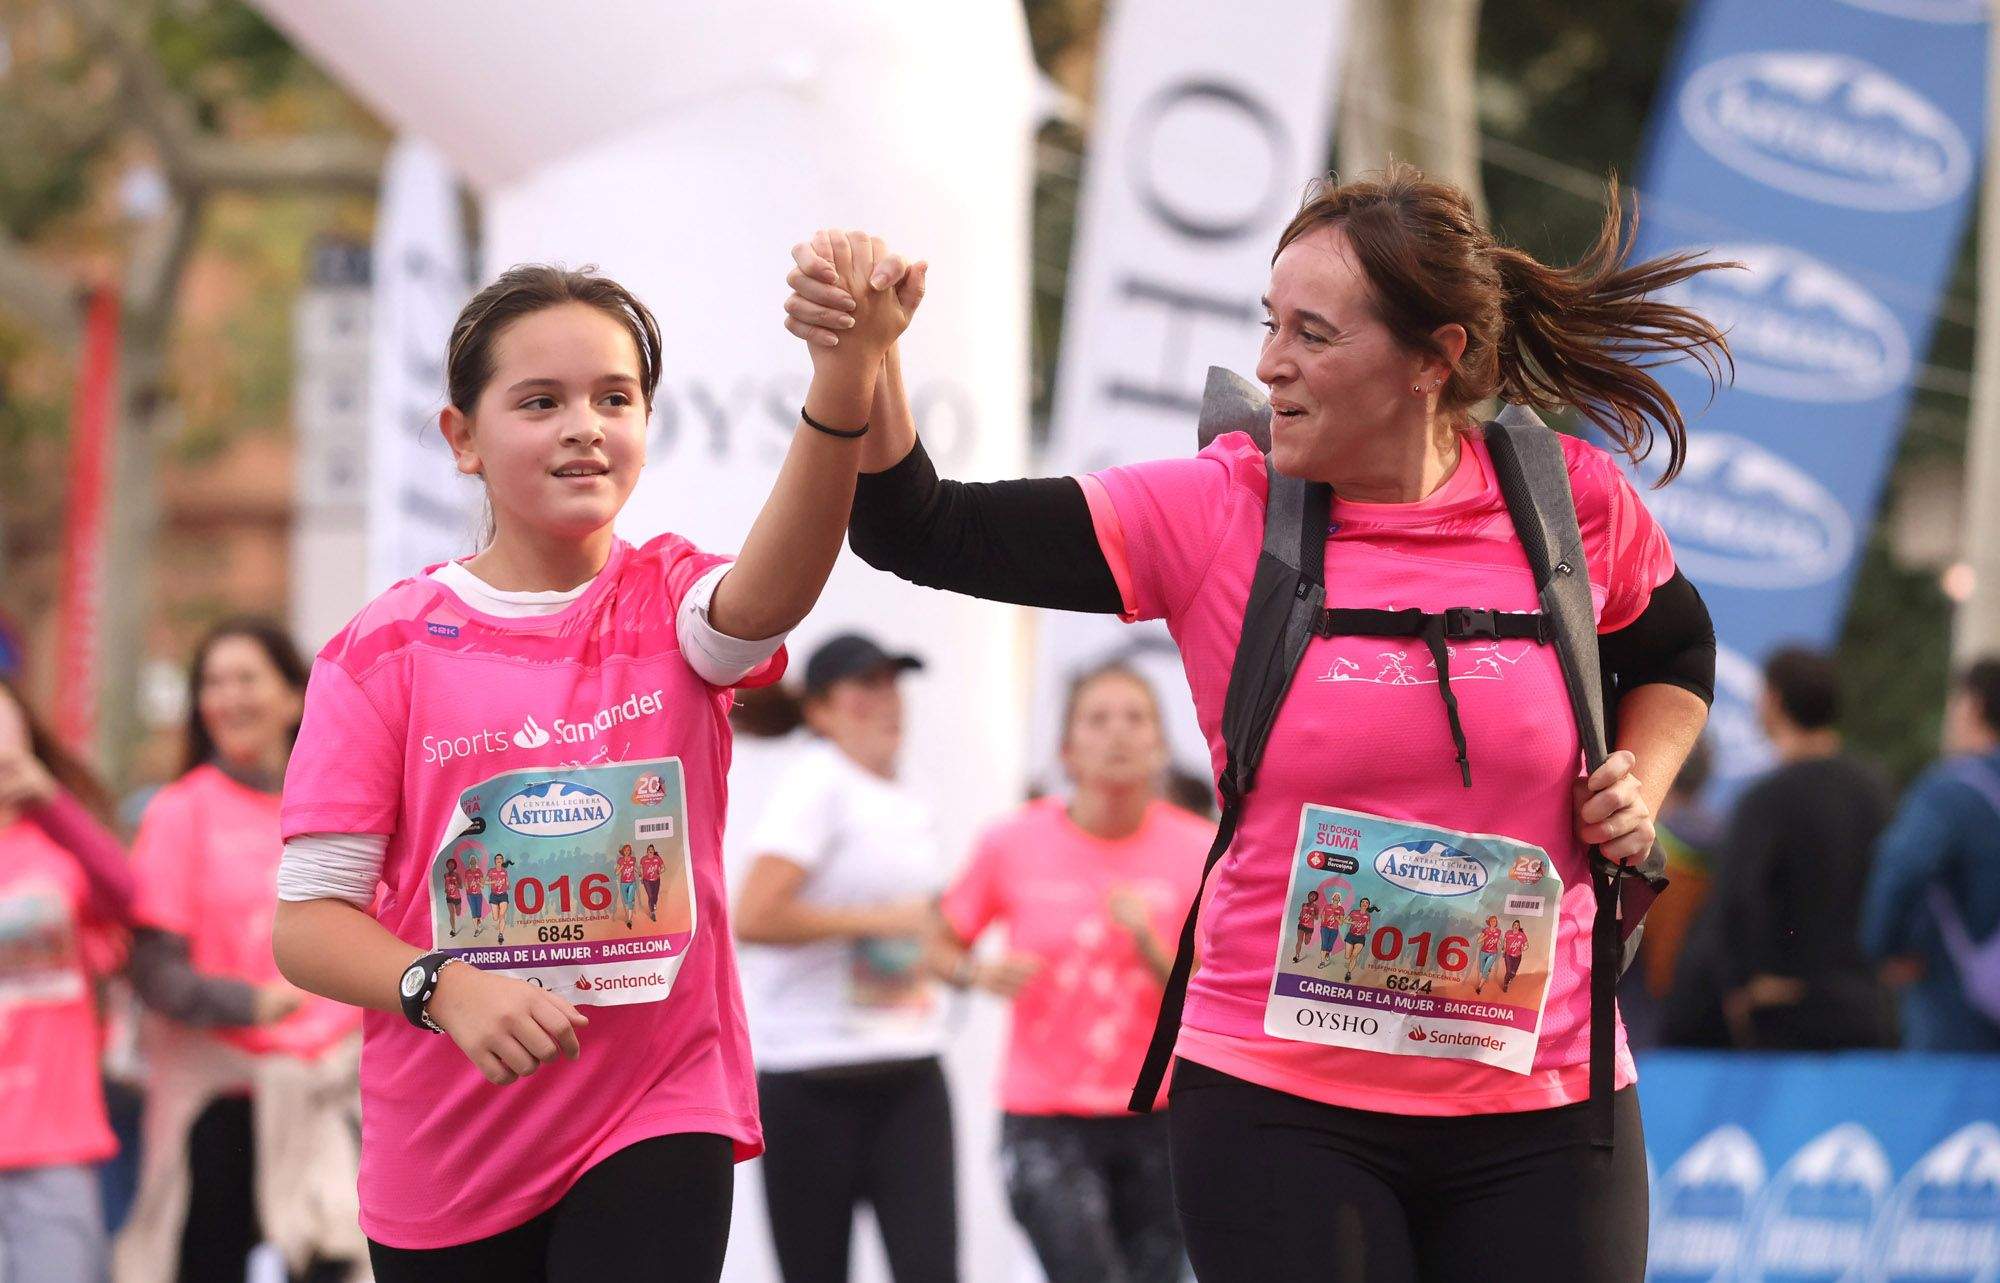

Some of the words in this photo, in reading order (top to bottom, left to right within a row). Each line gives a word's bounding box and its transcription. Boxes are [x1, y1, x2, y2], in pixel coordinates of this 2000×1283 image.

[422, 729, 509, 767] Sports
[523, 800, 559, 808] CENTRAL
[563, 798, 601, 806] LECHERA
[507, 804, 606, 826] ASTURIANA
[1316, 832, 1360, 851] SUMA
[1317, 823, 1328, 832] TU
[1330, 825, 1362, 838] DORSAL
[1381, 854, 1479, 887] ASTURIANA
[513, 872, 613, 915] 016
[538, 924, 584, 942] 6845
[461, 951, 511, 965] CARRERA
[514, 950, 529, 962] DE
[532, 949, 548, 961] LA
[550, 947, 591, 961] MUJER
[602, 939, 672, 957] BARCELONA
[1371, 926, 1470, 972] 016
[594, 972, 666, 991] Santande
[1386, 974, 1432, 995] 6844
[1299, 980, 1353, 1000] CARRERA
[1357, 990, 1373, 1002] DE
[1376, 993, 1391, 1005] LA
[1394, 996, 1434, 1012] MUJER
[1444, 1002, 1514, 1021] BARCELONA
[1296, 1008, 1379, 1036] OYSHO
[1429, 1030, 1506, 1051] Santander
